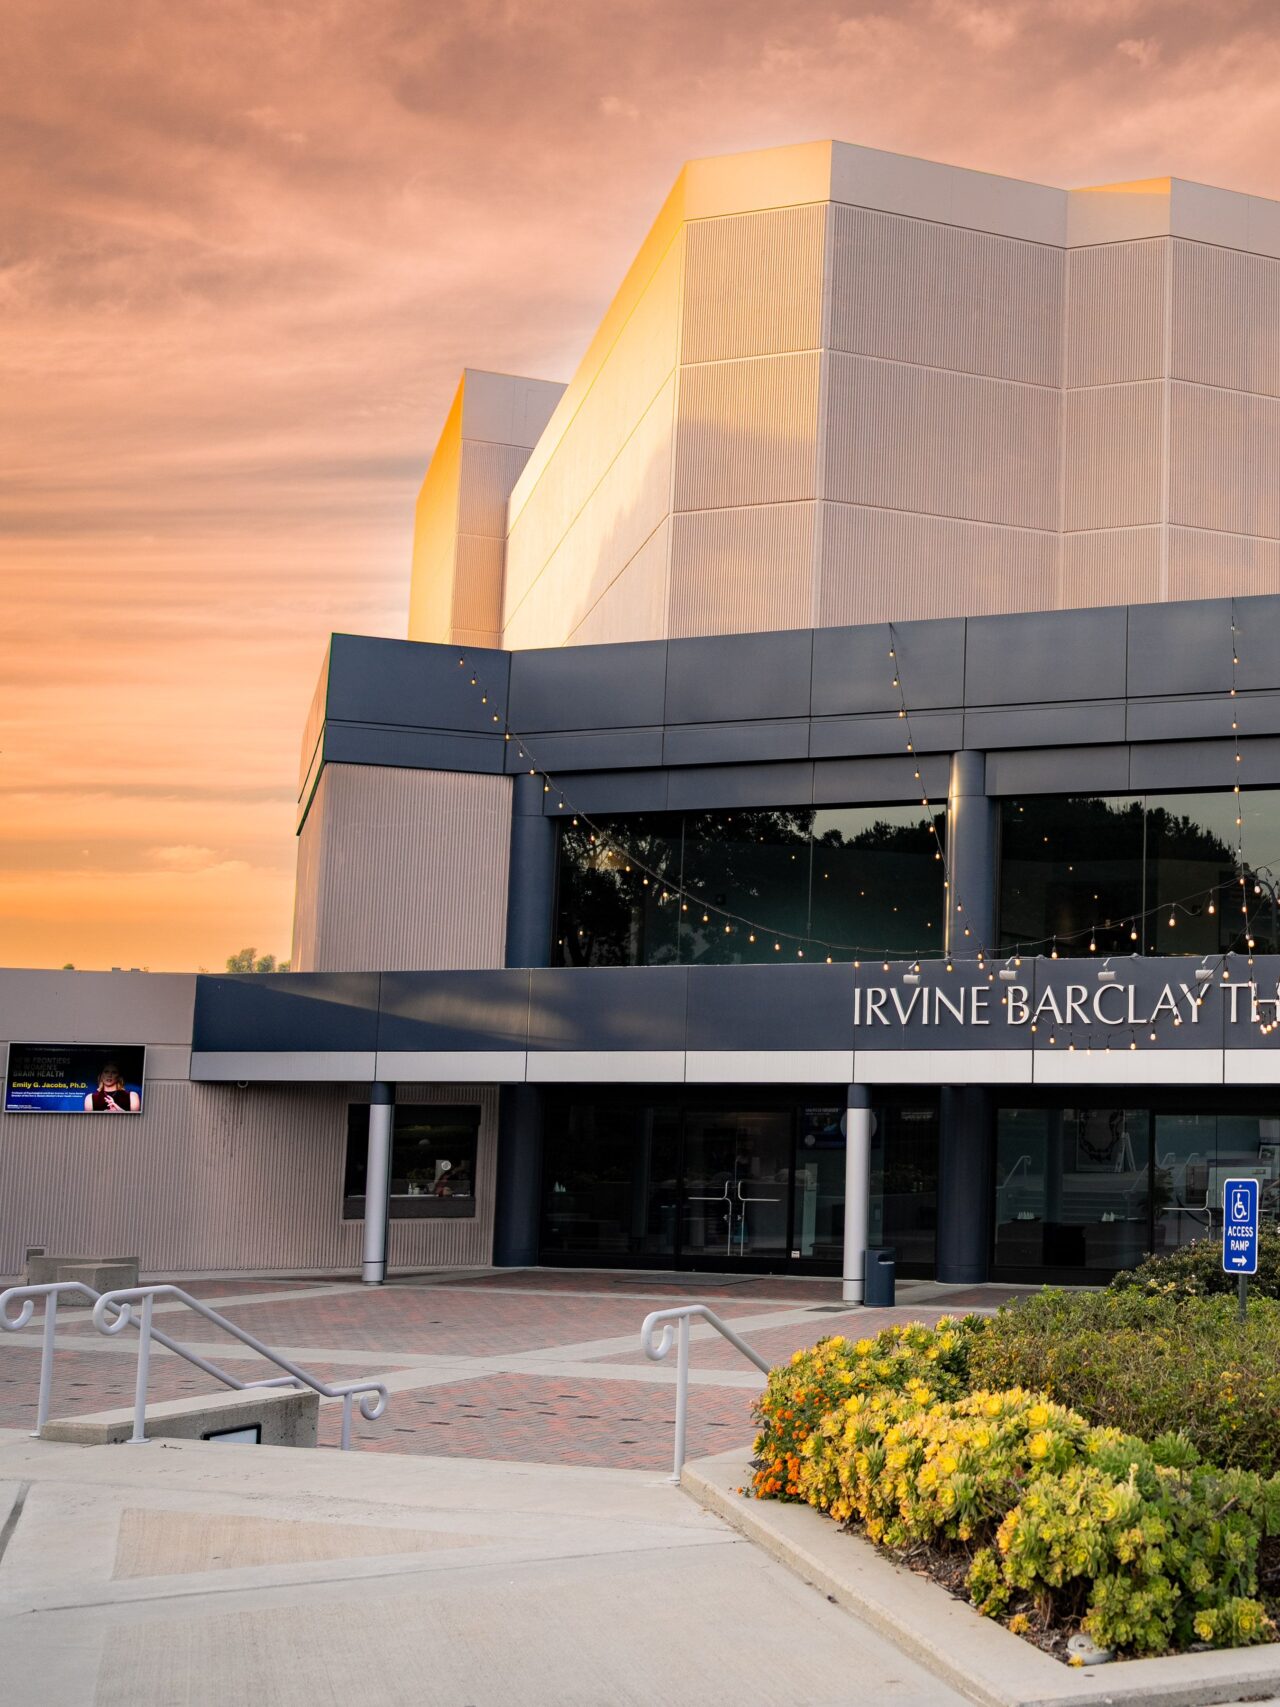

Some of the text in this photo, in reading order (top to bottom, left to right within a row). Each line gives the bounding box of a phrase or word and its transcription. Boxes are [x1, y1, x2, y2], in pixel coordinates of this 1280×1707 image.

[853, 986, 991, 1026] IRVINE
[1007, 983, 1211, 1025] BARCLAY
[1227, 1226, 1254, 1237] ACCESS
[1230, 1240, 1250, 1251] RAMP
